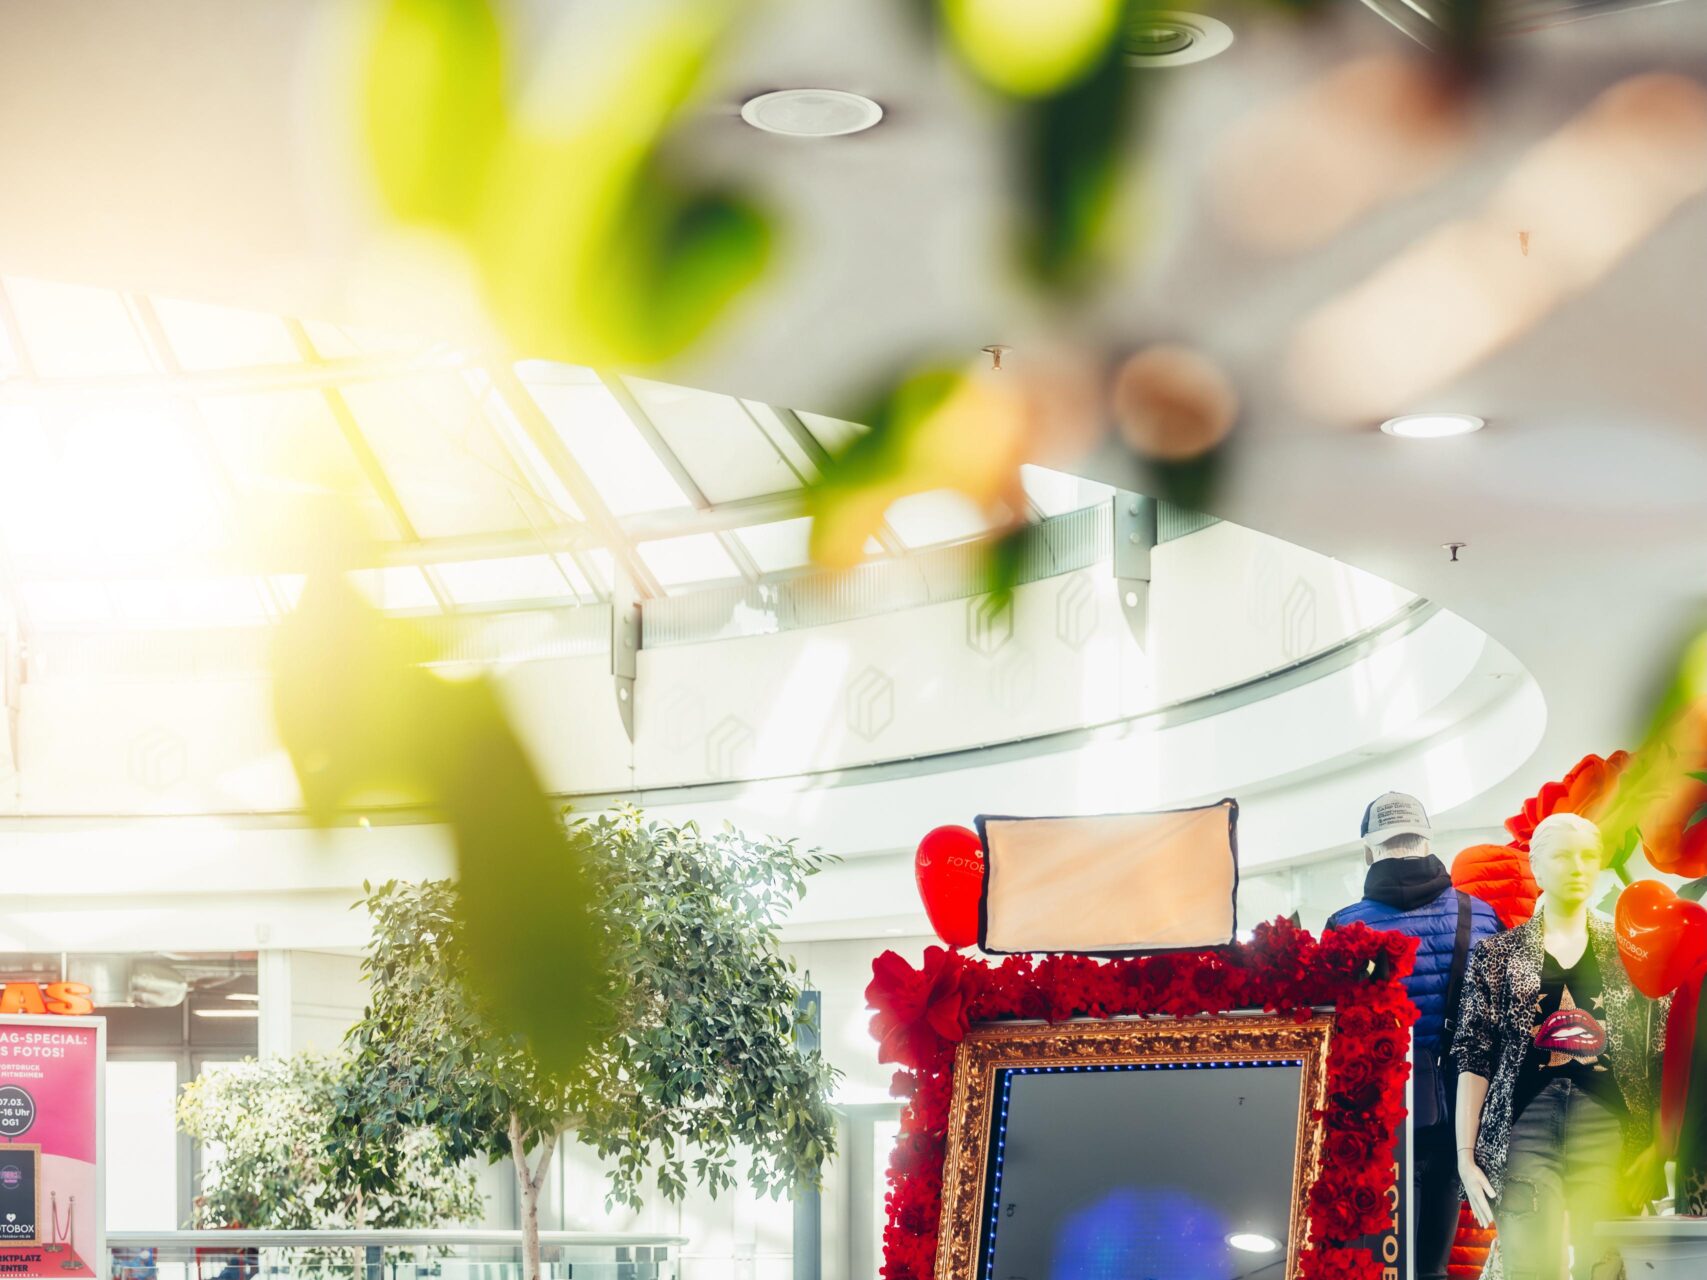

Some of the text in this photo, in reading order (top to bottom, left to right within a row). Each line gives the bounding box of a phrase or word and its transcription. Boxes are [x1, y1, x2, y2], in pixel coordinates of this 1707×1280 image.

[0, 1032, 88, 1045] AG-SPECIAL:
[13, 1046, 65, 1058] FOTOS!
[15, 1108, 30, 1116] Uhr
[2, 1118, 19, 1126] OG1
[0, 1225, 34, 1233] TOBOX
[0, 1264, 28, 1272] ENTER
